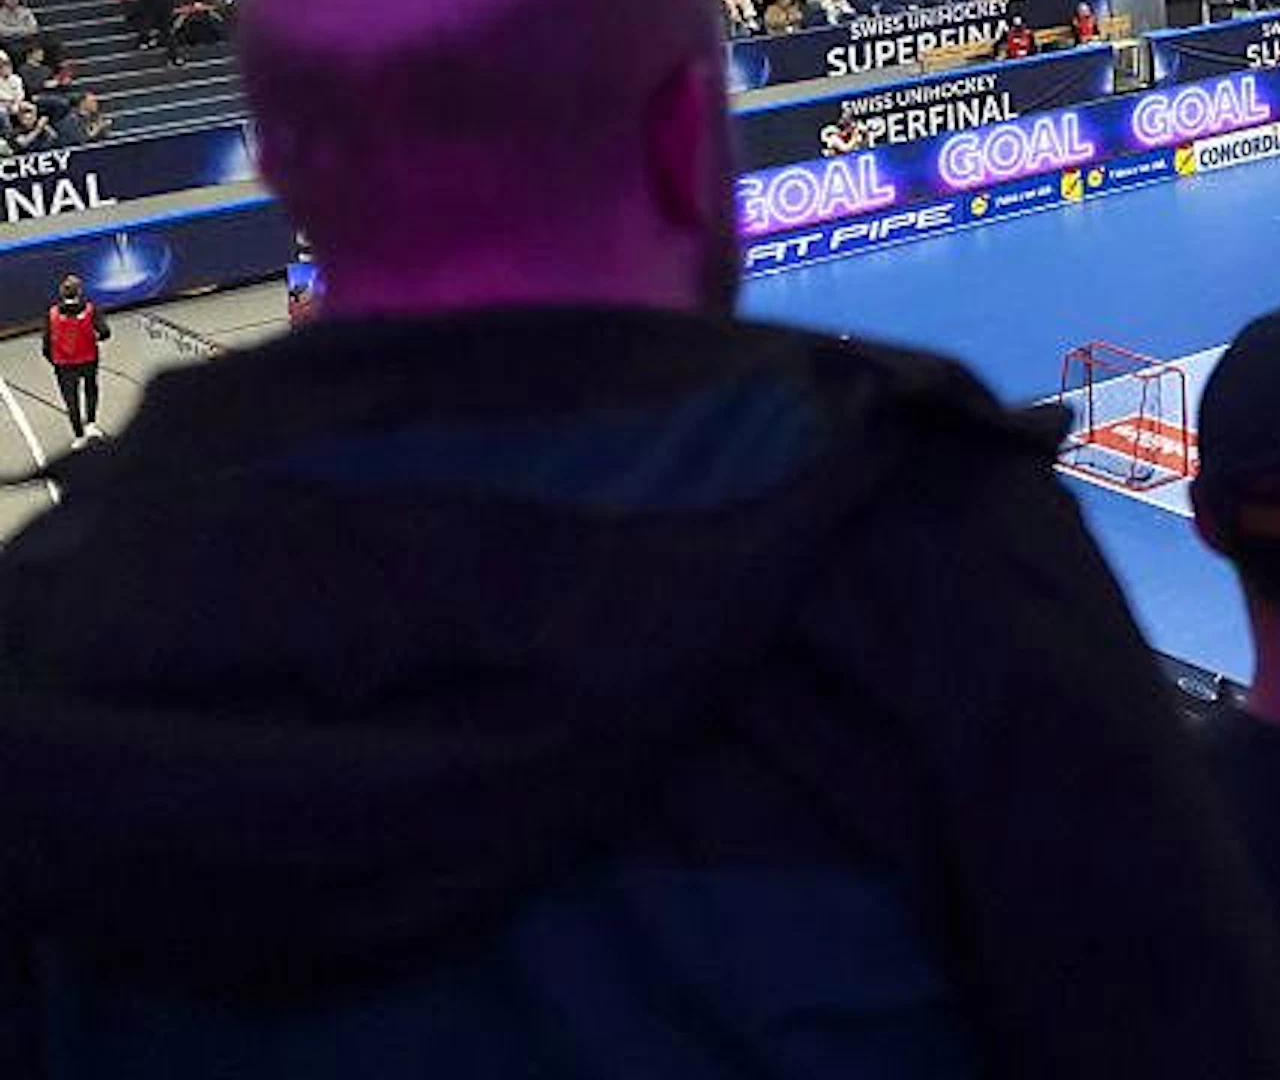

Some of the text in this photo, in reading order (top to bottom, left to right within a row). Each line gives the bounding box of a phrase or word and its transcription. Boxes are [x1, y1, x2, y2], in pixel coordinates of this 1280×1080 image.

[827, 19, 1011, 78] SUPERFINA
[851, 0, 1007, 41] SWISS UNIHOCKEY
[820, 94, 1019, 157] SPERFINAL
[841, 75, 998, 123] SWISS UNIHOCKEY
[1131, 76, 1271, 147] GOAL
[0, 149, 72, 182] CKEY
[938, 112, 1095, 189] GOAL
[4, 174, 117, 224] NAL
[745, 203, 956, 270] AT PIPE
